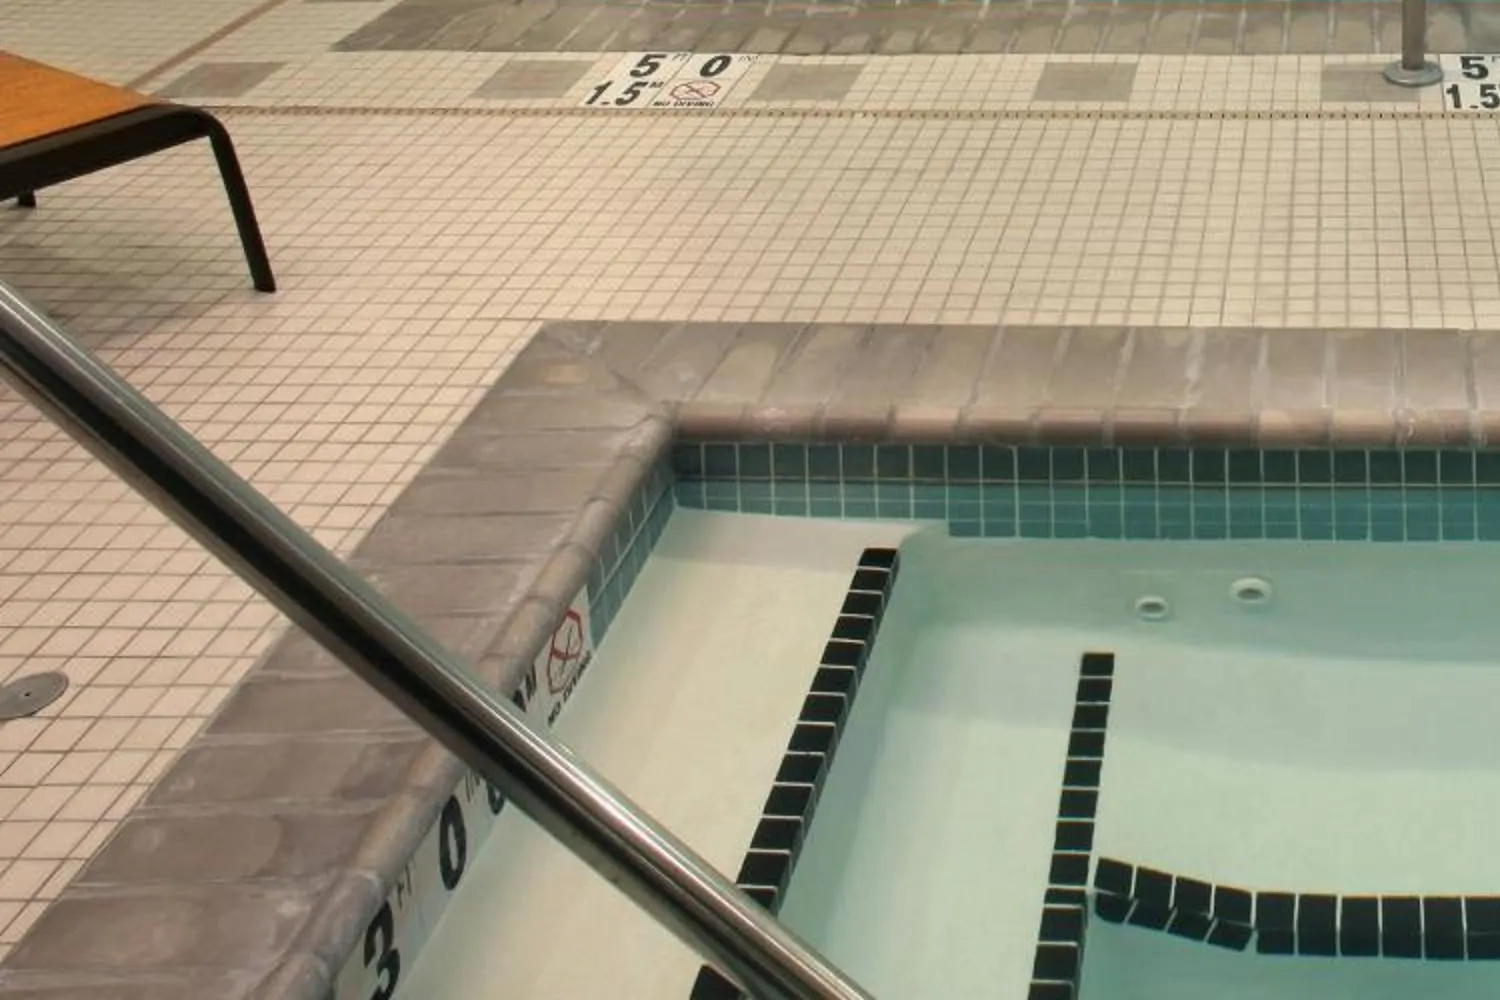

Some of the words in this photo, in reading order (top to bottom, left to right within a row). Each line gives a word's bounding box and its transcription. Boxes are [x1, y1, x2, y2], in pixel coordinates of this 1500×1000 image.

[629, 54, 667, 78] 5
[699, 54, 732, 78] 0
[1460, 55, 1489, 80] 5
[585, 81, 648, 106] 1.5
[1445, 83, 1500, 109] 1.5
[364, 899, 400, 1000] 3
[439, 794, 466, 891] 0
